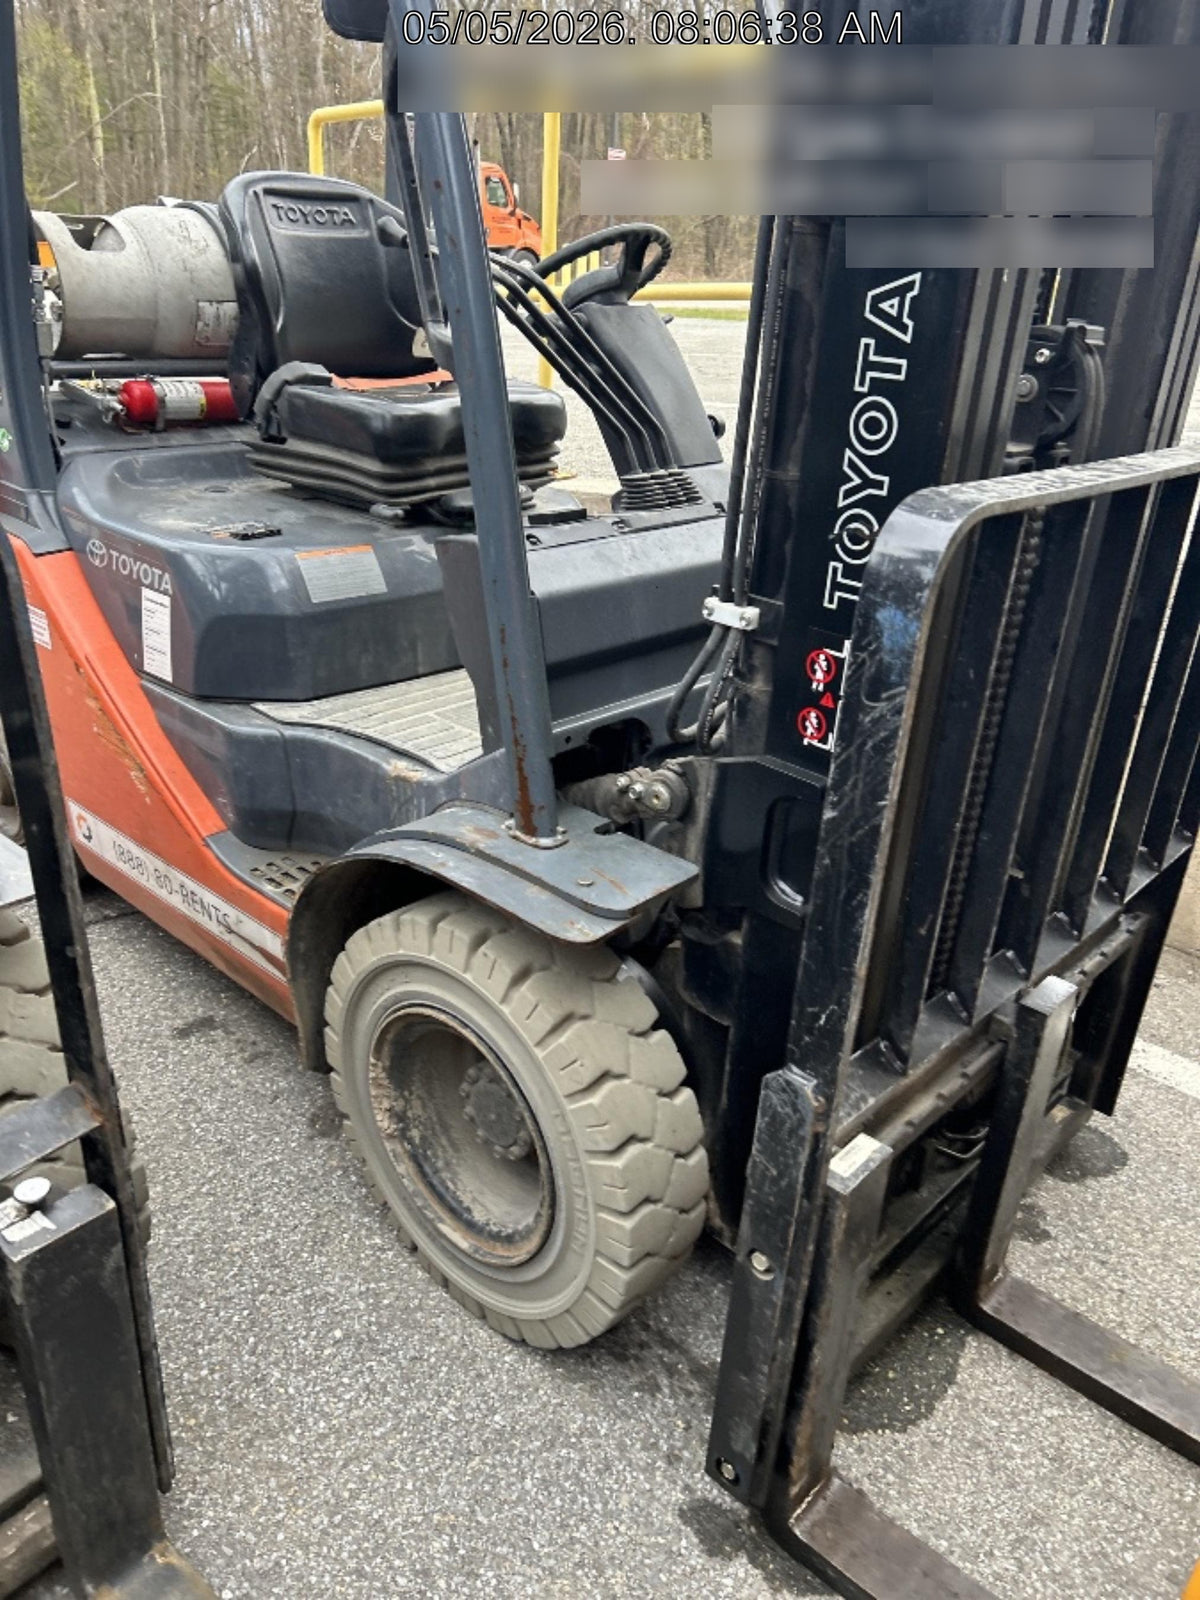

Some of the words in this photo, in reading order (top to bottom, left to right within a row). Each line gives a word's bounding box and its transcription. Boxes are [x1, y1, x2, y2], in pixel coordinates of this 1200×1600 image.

[271, 203, 357, 226] TOYOTA
[823, 271, 922, 610] TOYOTA
[109, 549, 173, 595] TOYOTA
[112, 840, 150, 882] (888)
